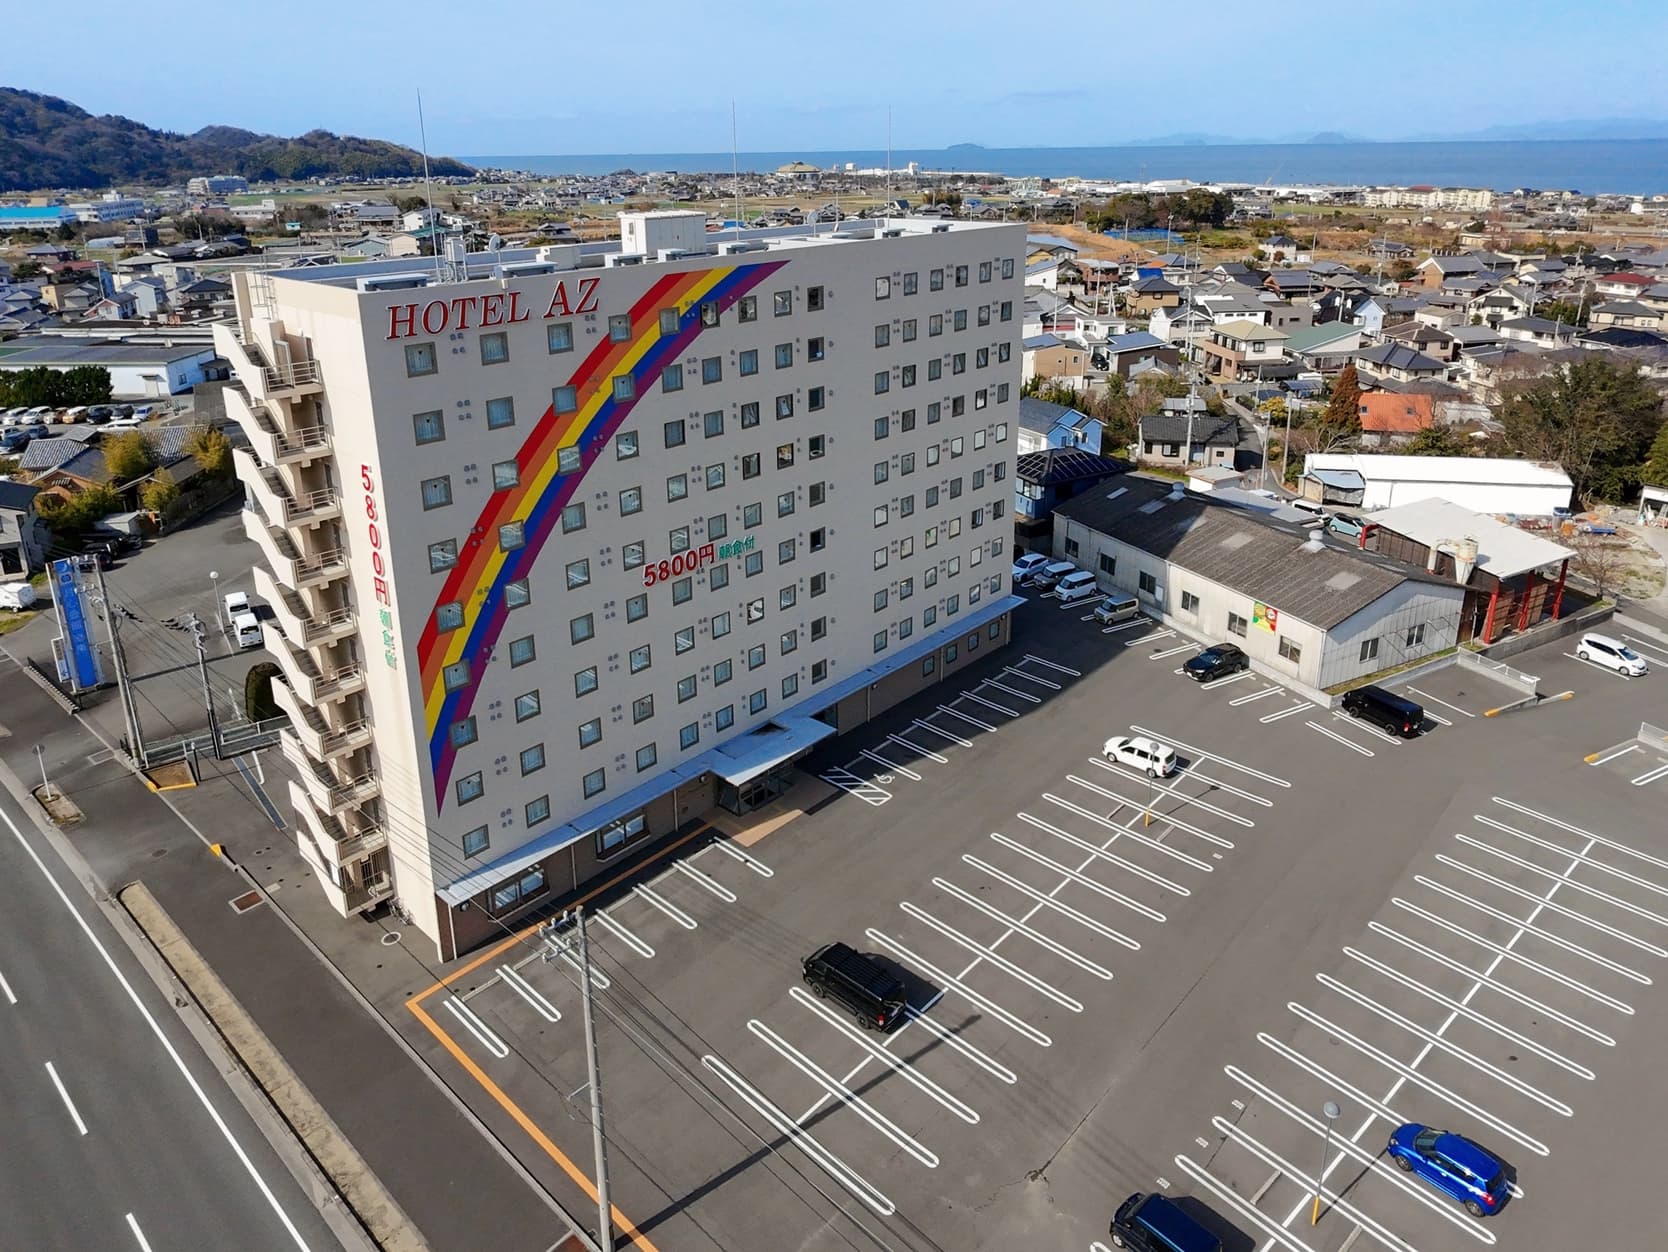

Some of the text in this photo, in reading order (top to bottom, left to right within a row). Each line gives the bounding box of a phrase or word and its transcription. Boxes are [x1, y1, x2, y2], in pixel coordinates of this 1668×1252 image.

[386, 277, 601, 340] HOTEL AZ
[361, 464, 390, 608] 5800円
[643, 543, 715, 588] 5800円
